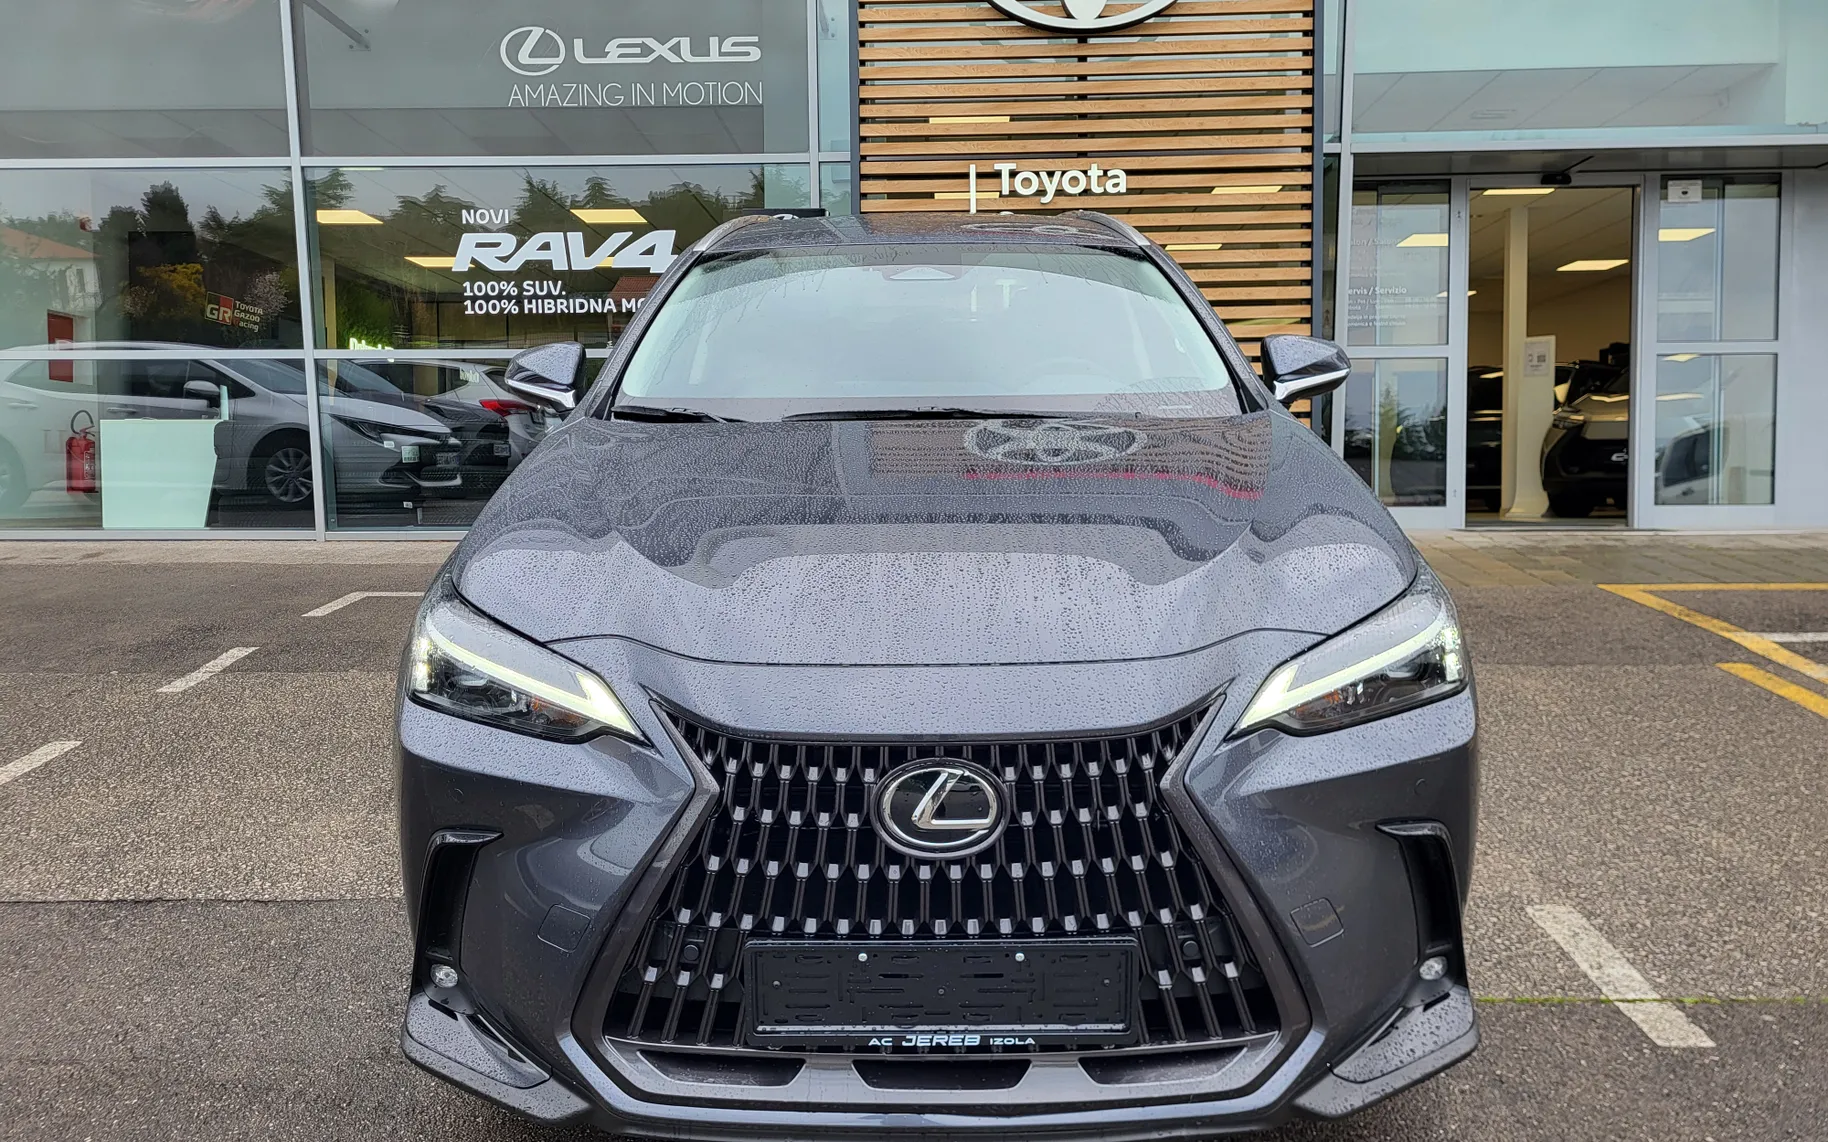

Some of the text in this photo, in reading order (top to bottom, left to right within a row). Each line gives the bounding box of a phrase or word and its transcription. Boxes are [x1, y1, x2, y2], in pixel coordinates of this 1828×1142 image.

[573, 36, 761, 64] LEXUS
[507, 81, 763, 107] AMAZING IN MOTION
[993, 162, 1127, 204] Toyota
[461, 208, 510, 224] NOVI
[452, 229, 679, 273] RAV4
[463, 280, 566, 297] 100% SUV.
[1375, 285, 1408, 295] Servizio
[206, 304, 231, 322] GR
[235, 300, 264, 315] TOYOTA
[464, 299, 519, 315] 100%
[524, 297, 617, 314] HIBRIDNA
[233, 309, 261, 323] GAZOO
[868, 1034, 1036, 1047] AC JEREB IZOLA
